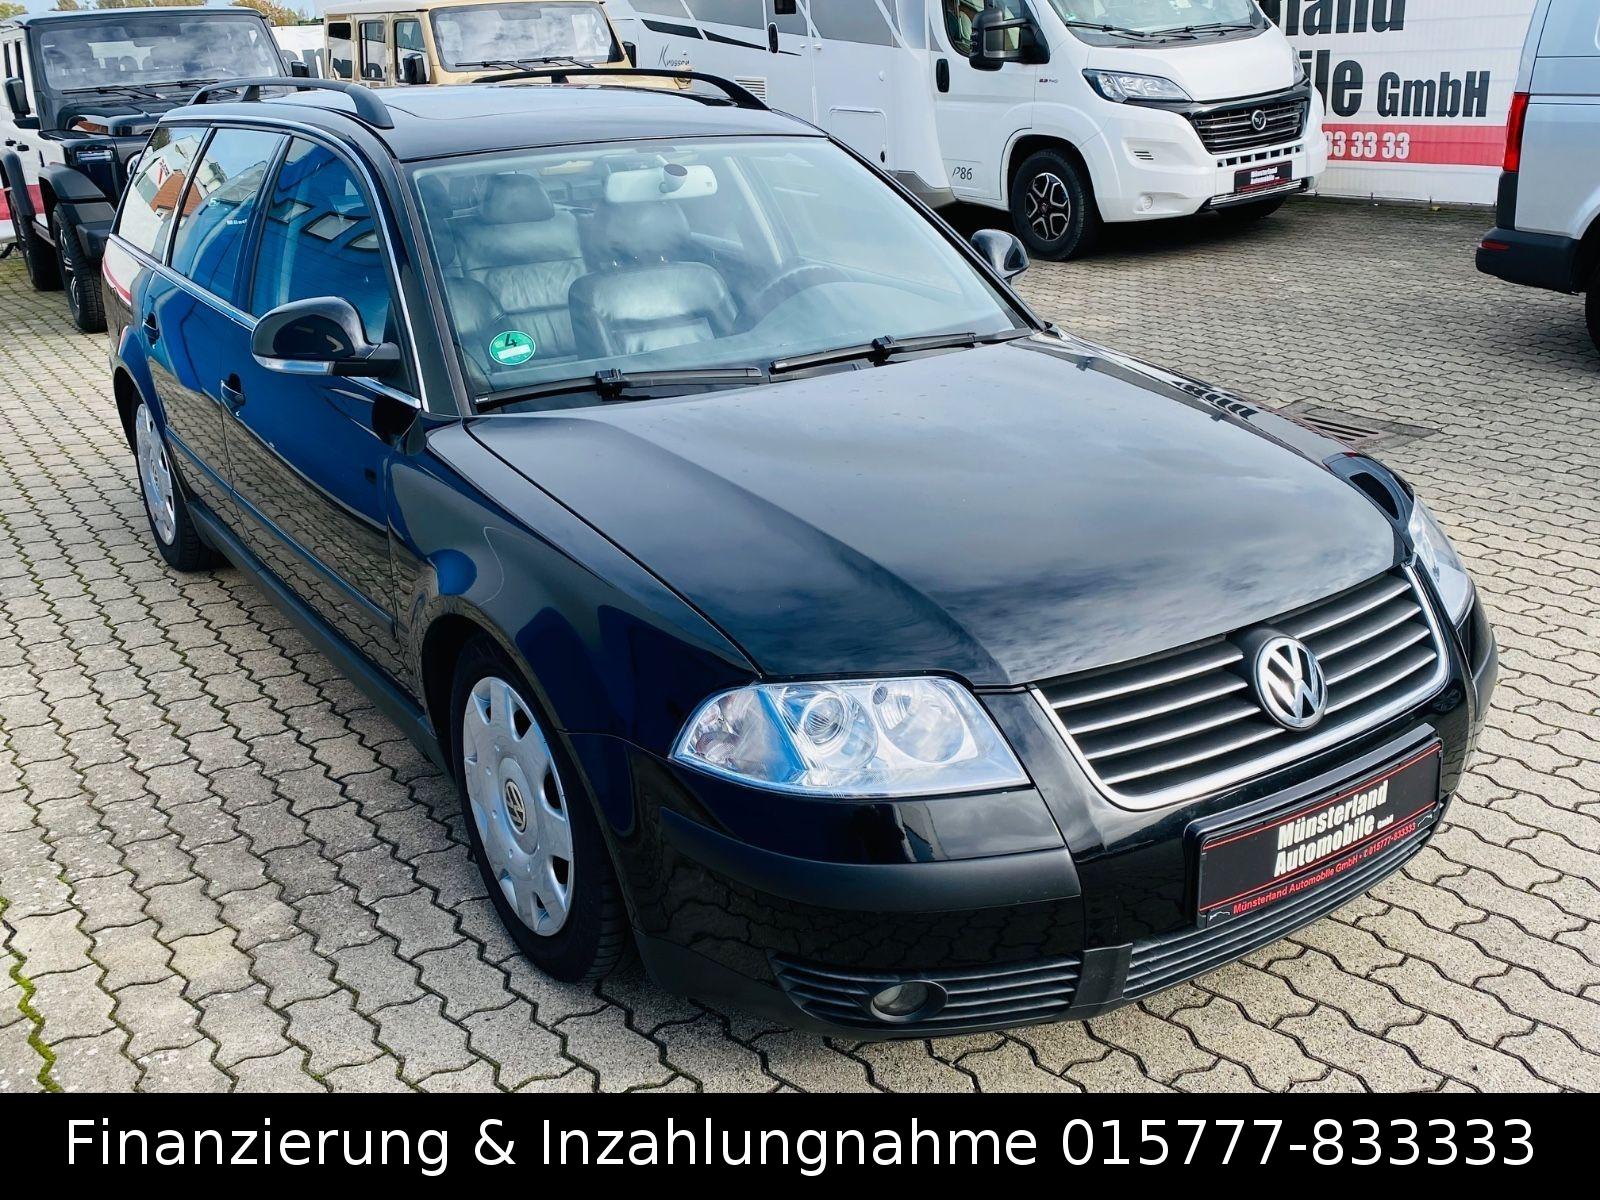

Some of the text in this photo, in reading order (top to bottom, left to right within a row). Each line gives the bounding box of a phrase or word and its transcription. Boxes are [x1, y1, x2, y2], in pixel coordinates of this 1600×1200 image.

[1377, 71, 1491, 118] GmbH
[1350, 131, 1378, 158] 33
[1381, 132, 1410, 159] 33
[952, 166, 973, 181] P86
[504, 333, 518, 347] 4
[1277, 779, 1389, 851] Münsterland
[1273, 814, 1375, 878] Automobile
[1233, 886, 1288, 914] Münsterland
[1288, 867, 1335, 894] Automobile
[1335, 855, 1359, 874] GmbH
